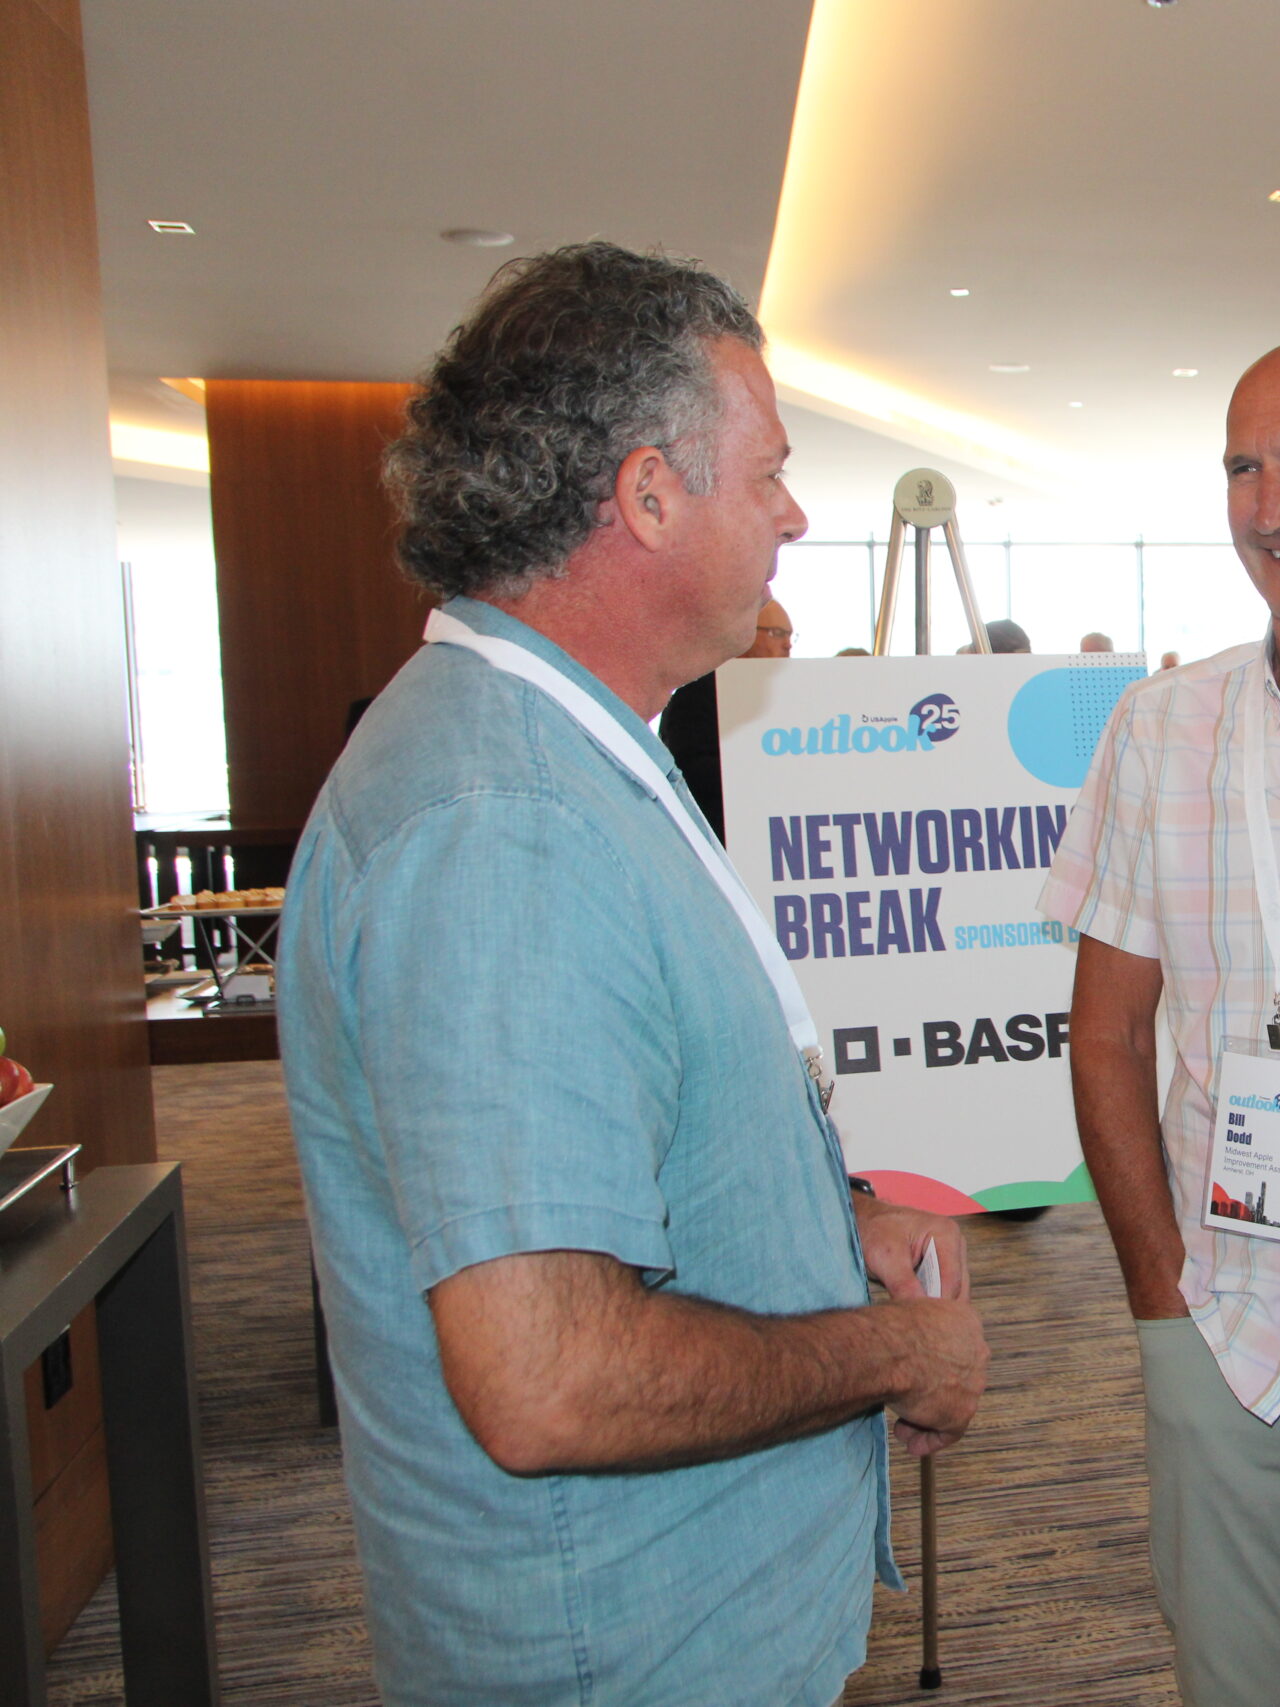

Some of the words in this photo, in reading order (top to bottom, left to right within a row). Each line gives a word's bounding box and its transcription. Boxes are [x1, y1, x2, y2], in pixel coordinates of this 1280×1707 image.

[761, 714, 936, 756] outlook
[921, 703, 961, 730] 25
[769, 805, 1075, 881] NETWORKIN
[774, 887, 947, 960] BREAK
[954, 920, 1063, 950] SPONSORED
[1067, 924, 1080, 943] B
[923, 1012, 1071, 1068] BASF
[1229, 1094, 1280, 1113] outlook
[1228, 1112, 1245, 1127] Bill
[1226, 1129, 1252, 1145] Dodd
[1224, 1156, 1267, 1170] Improvement
[1225, 1146, 1252, 1158] Midwest
[1254, 1152, 1273, 1162] Apple
